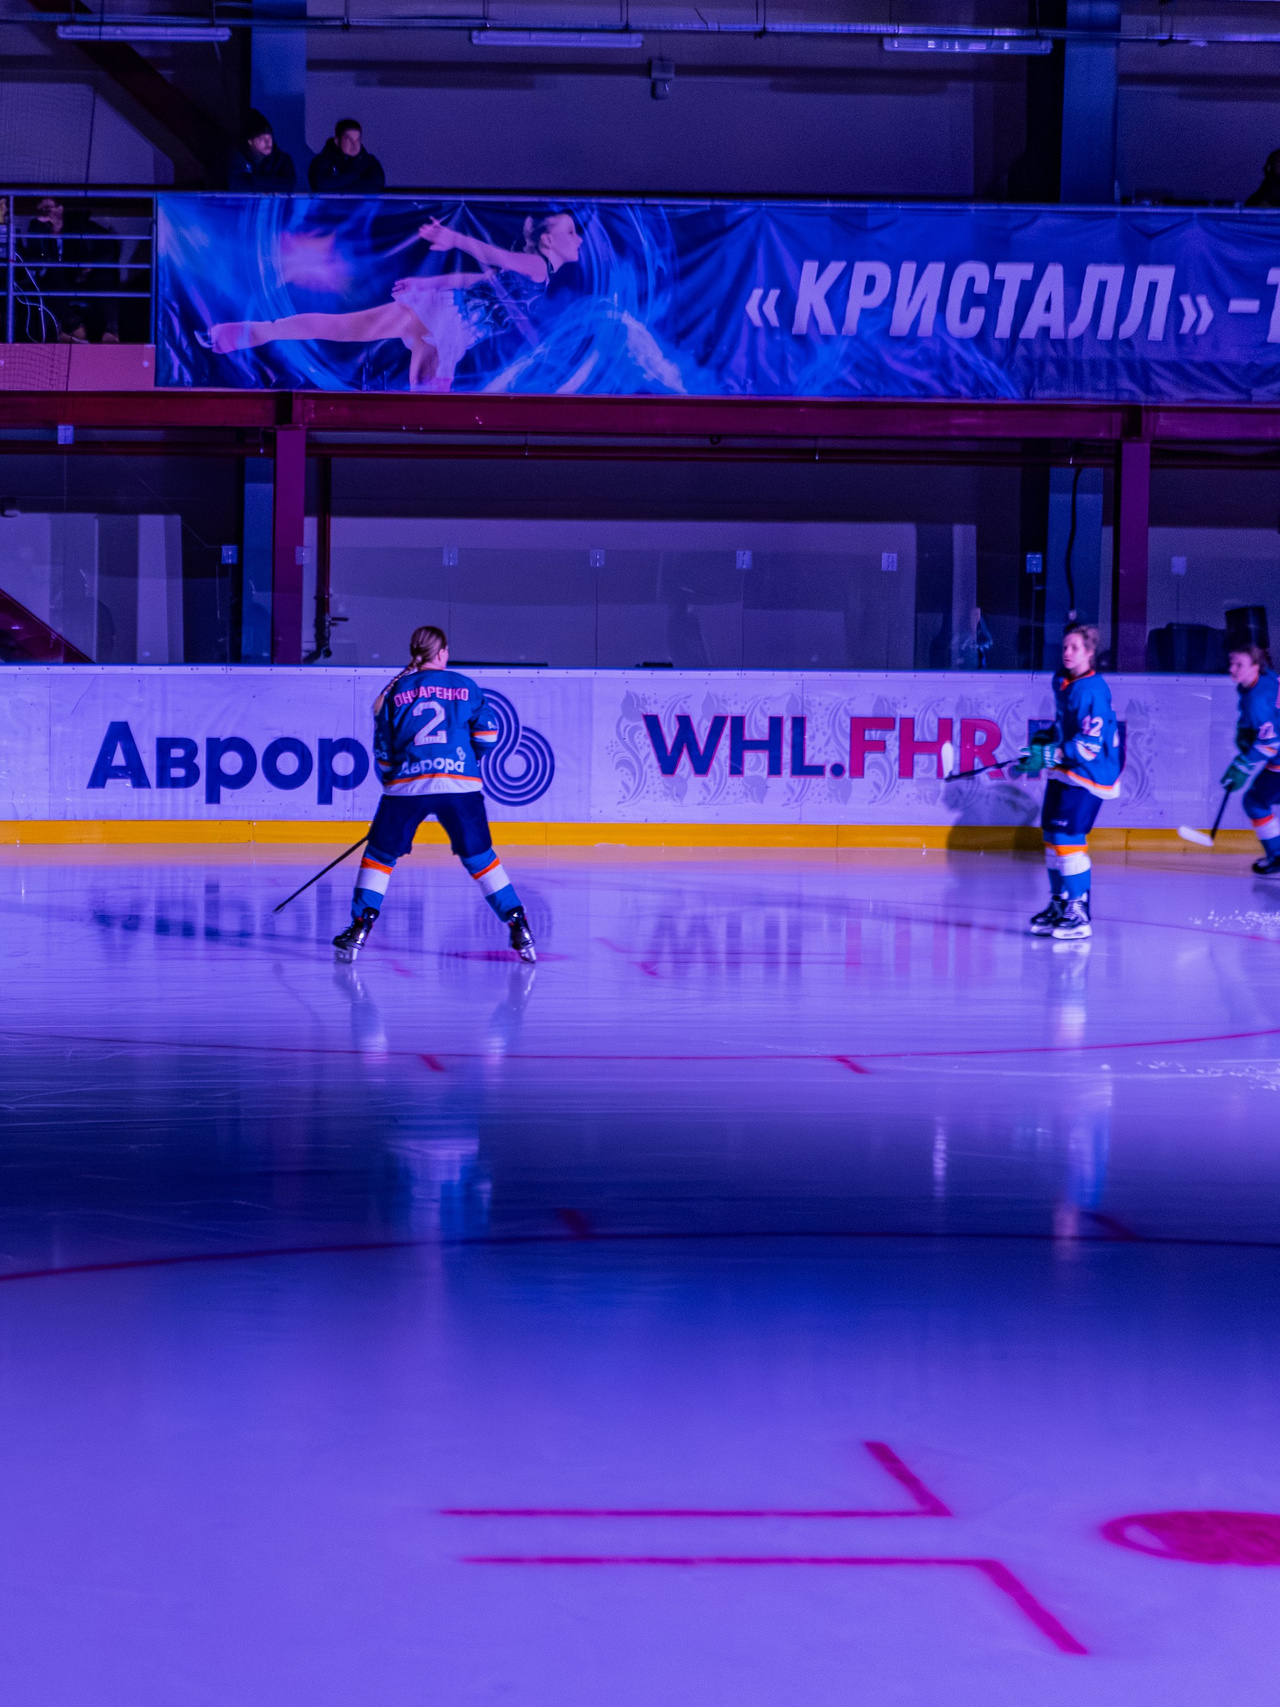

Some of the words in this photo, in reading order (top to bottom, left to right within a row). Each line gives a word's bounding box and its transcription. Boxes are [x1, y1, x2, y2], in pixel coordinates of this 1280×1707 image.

[745, 259, 1214, 341] «КРИСТАЛЛ»
[412, 701, 448, 747] 2
[642, 713, 1127, 780] WHL.FHR.
[1082, 715, 1104, 737] 12
[86, 720, 383, 805] Аврор
[398, 757, 466, 776] Аврора
